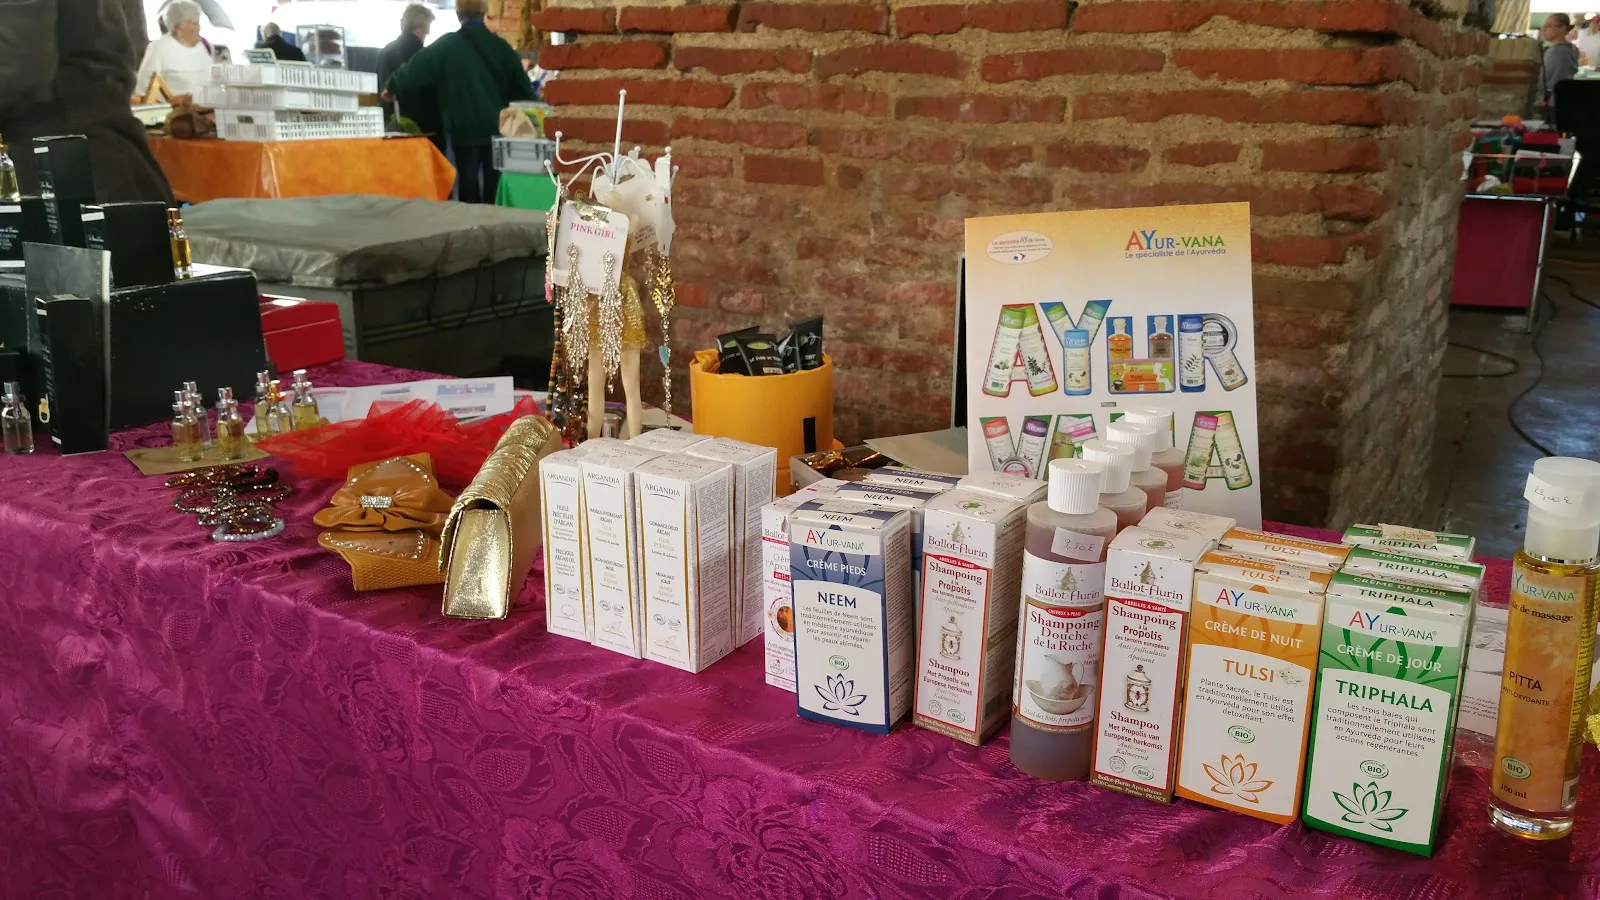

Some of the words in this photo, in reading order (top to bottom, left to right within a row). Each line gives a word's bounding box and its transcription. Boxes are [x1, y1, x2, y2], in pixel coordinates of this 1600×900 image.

[570, 222, 593, 234] PINK
[594, 228, 616, 240] GIRL
[546, 472, 576, 483] ARGANDIA
[587, 472, 620, 484] ARGANDIA
[894, 477, 924, 485] NEEM
[644, 483, 680, 496] ARGANDIA
[863, 493, 894, 502] NEEM
[1535, 485, 1559, 502] 22,00
[821, 513, 853, 522] NEEM
[1264, 545, 1301, 556] TULSI
[1371, 539, 1438, 550] TRIPHALA
[766, 560, 788, 571] l'Apicu
[806, 559, 838, 572] CRÈME
[840, 564, 866, 576] PIEDS
[930, 561, 982, 585] Shampoing
[1378, 561, 1448, 579] TRIPHALA
[1430, 562, 1460, 570] JOUR
[1241, 570, 1280, 582] TULSI
[938, 580, 971, 595] Propolis
[1415, 588, 1447, 596] JOUR
[1514, 570, 1576, 601] YUR-VANA
[818, 591, 856, 608] NEEM
[1124, 600, 1146, 608] ABEILLES
[1358, 588, 1434, 608] TRIPHALA
[800, 612, 852, 626] traditionnellement
[813, 607, 832, 616] feuilles
[1112, 605, 1177, 630] Shampoing
[1520, 604, 1530, 614] de
[1531, 610, 1573, 623] massage
[812, 621, 838, 630] médecine
[840, 626, 874, 637] ayurvédique
[1030, 611, 1100, 633] Shampoing
[822, 637, 838, 645] peaux
[851, 635, 871, 643] réparer
[1041, 627, 1088, 640] Douche
[1124, 625, 1162, 642] Propolis
[1205, 620, 1247, 637] CRÈME
[1251, 630, 1266, 641] DE
[1271, 633, 1303, 649] NUIT
[1033, 636, 1045, 647] de
[1047, 640, 1056, 649] la
[1059, 640, 1093, 652] Ruche
[1144, 641, 1169, 650] européens
[1337, 644, 1382, 661] CRÈME
[1387, 654, 1403, 666] DE
[1405, 659, 1441, 672] JOUR
[929, 658, 970, 677] Shampoo
[1223, 658, 1274, 683] TULSI
[927, 670, 936, 678] Met
[938, 673, 958, 684] Propolis
[1510, 671, 1543, 692] PITTA
[924, 676, 946, 688] Europese
[948, 684, 972, 696] herkomst
[1201, 678, 1224, 689] Plante
[1225, 684, 1251, 696] Sacrée,
[1254, 690, 1260, 698] le
[1263, 692, 1280, 702] Tulsi
[1199, 686, 1268, 707] traditionnellement
[1271, 703, 1294, 714] utilisé
[1336, 680, 1433, 712] TRIPHALA
[1207, 696, 1240, 709] Ayurvéda
[1242, 705, 1259, 714] pour
[1262, 710, 1275, 718] son
[1277, 713, 1295, 722] effet
[1347, 702, 1359, 710] Les
[1362, 705, 1380, 715] trois
[1382, 709, 1403, 720] baies
[1405, 715, 1418, 723] qui
[1058, 716, 1079, 724] propolis
[1110, 710, 1159, 730] Shampoo
[1328, 707, 1371, 722] composent
[1374, 716, 1380, 724] le
[1384, 718, 1415, 731] Triphala
[1418, 726, 1436, 735] sont
[1108, 723, 1120, 731] Met
[1122, 726, 1147, 738] Propolis
[1235, 730, 1248, 738] BIO
[1326, 714, 1400, 736] traditionnellement
[1402, 732, 1436, 744] utilisées
[1104, 730, 1131, 742] Europese
[1134, 738, 1163, 750] herkomst
[1336, 734, 1364, 746] actions
[1366, 741, 1420, 758] régénérantes.
[1346, 727, 1381, 740] Ayurvéda
[1384, 736, 1403, 745] pour
[1405, 740, 1425, 750] leurs
[1116, 748, 1149, 760] Kalmerend
[1367, 766, 1382, 774] BIO
[1507, 763, 1524, 774] BIO
[1146, 793, 1166, 802] FRANCE
[1500, 783, 1512, 793] 100
[1514, 790, 1527, 799] ml
